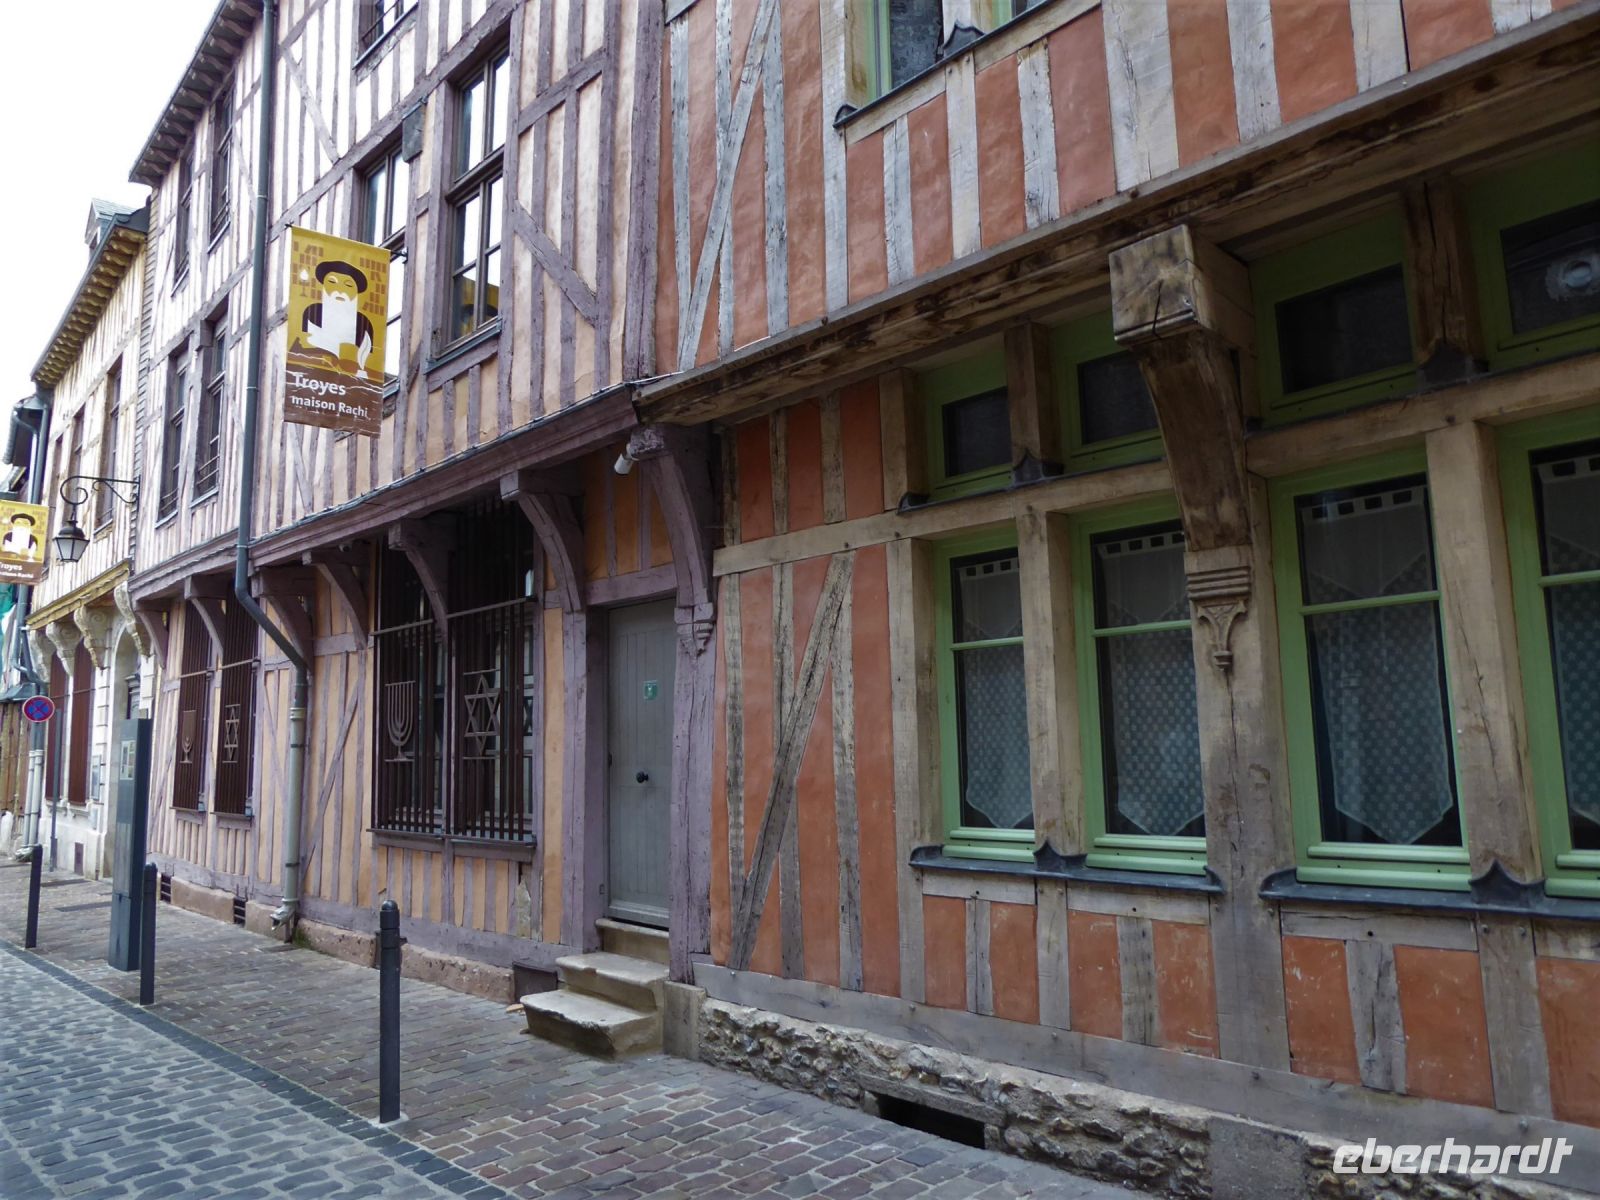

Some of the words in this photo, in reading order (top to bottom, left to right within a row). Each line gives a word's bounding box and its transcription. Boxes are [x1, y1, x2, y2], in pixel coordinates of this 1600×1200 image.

[293, 372, 346, 395] Troyes
[291, 396, 336, 411] maison
[338, 402, 368, 417] Rachi
